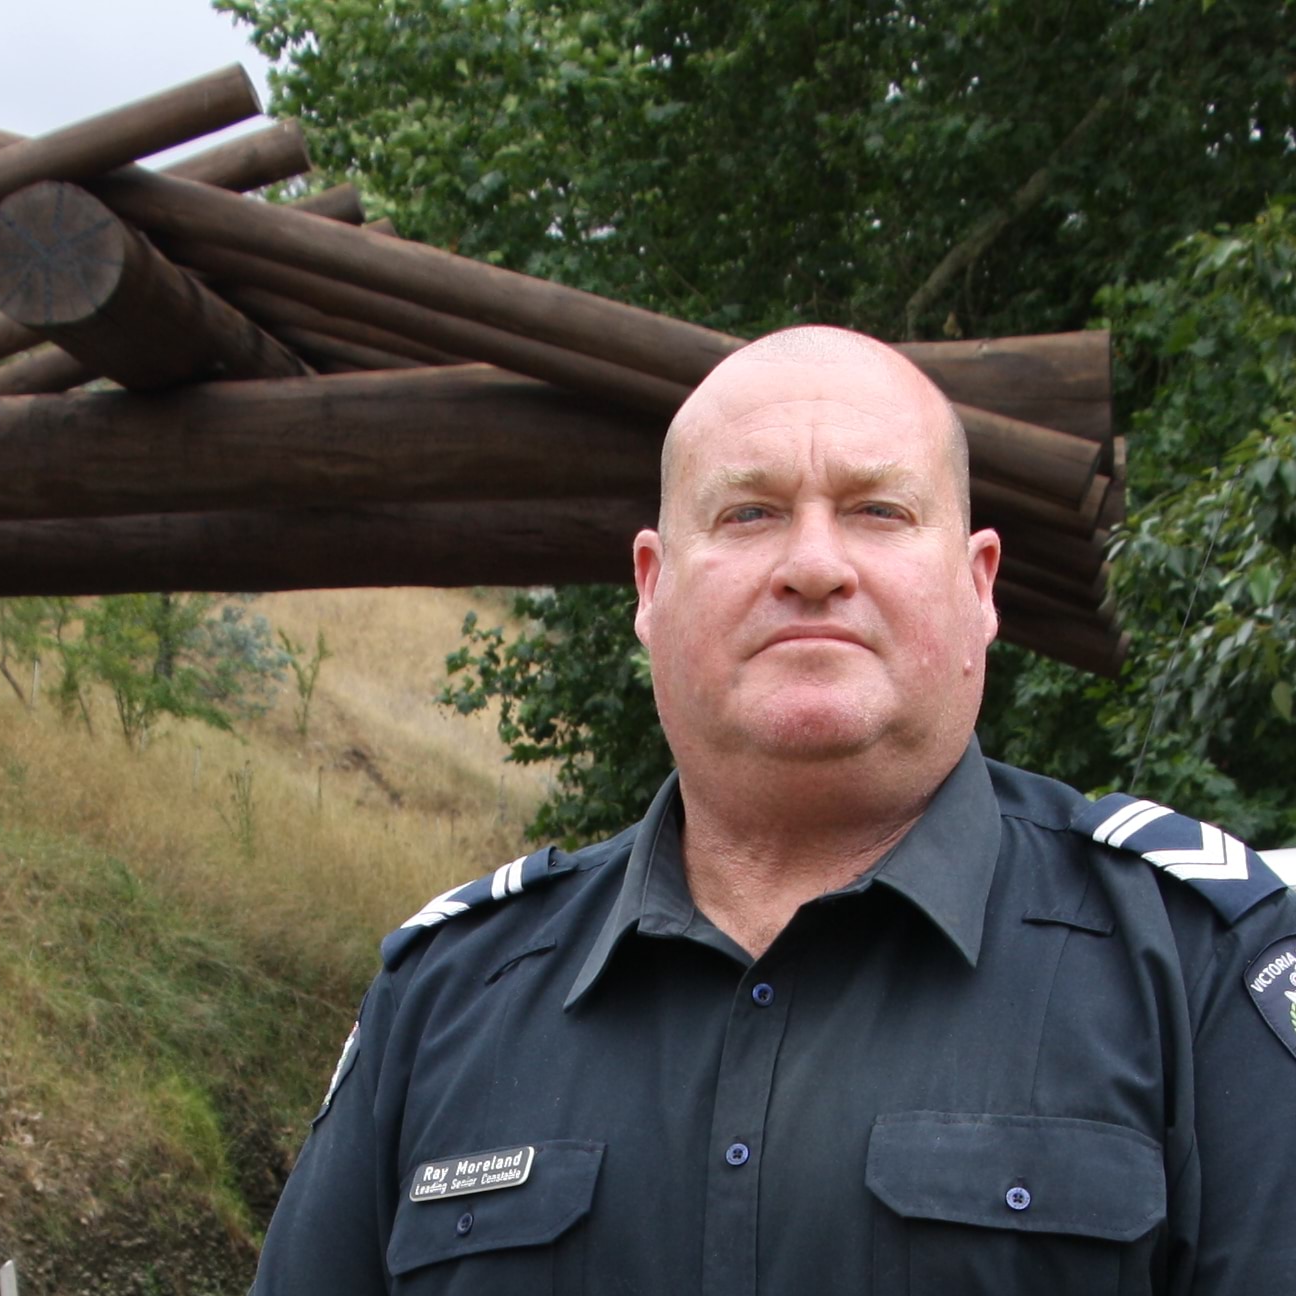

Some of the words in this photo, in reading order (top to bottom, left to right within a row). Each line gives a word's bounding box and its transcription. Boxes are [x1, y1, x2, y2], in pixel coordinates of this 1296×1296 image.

[423, 1166, 449, 1182] Ray
[455, 1150, 523, 1176] Moreland
[415, 1181, 448, 1195] Leading
[450, 1176, 478, 1190] Senior
[480, 1168, 522, 1185] Constable
